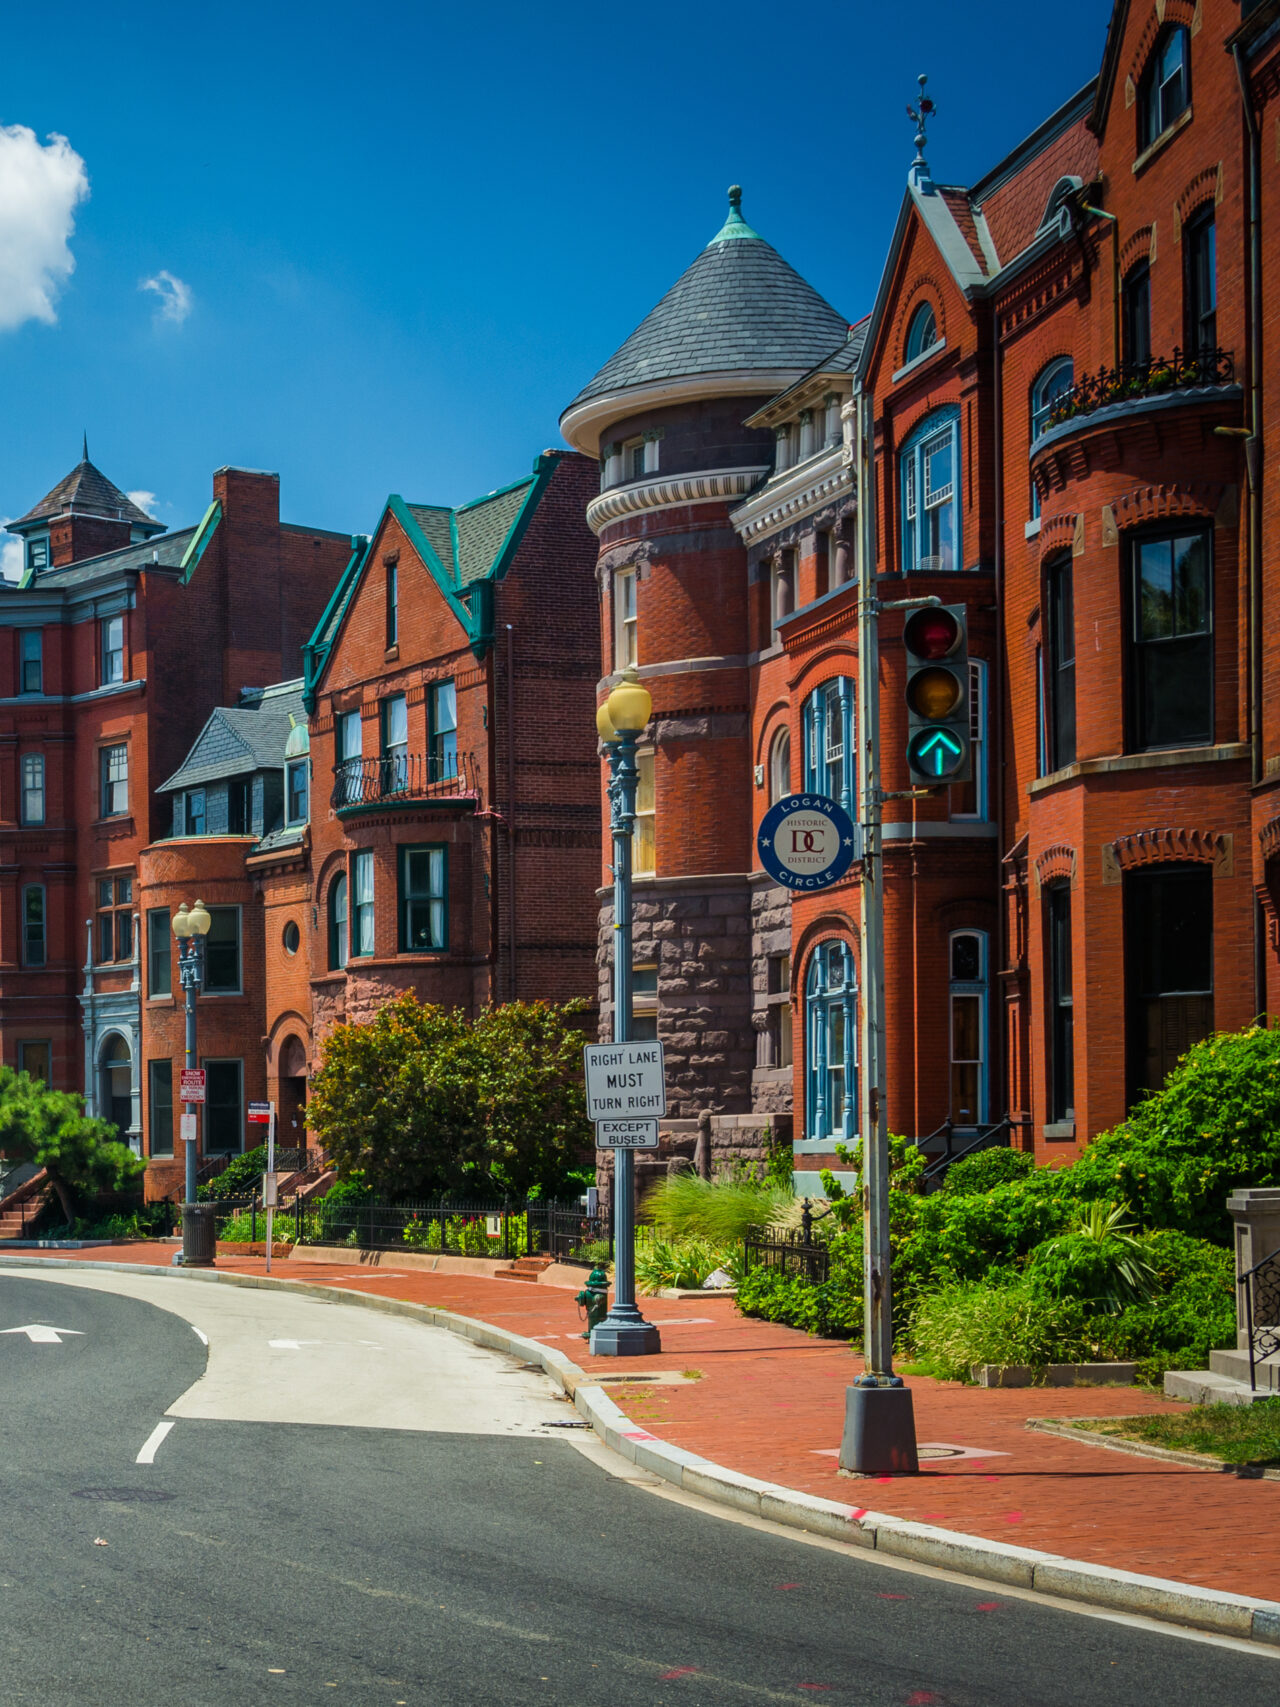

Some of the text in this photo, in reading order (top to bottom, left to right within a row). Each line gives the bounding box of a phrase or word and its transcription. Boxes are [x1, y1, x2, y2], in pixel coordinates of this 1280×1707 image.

[781, 798, 833, 812] LOGAN
[790, 830, 825, 853] DC
[779, 871, 834, 886] CIRCLE
[590, 1052, 658, 1066] RIGHT LANE
[607, 1073, 643, 1088] MUST
[593, 1095, 661, 1110] TURN RIGHT
[603, 1123, 651, 1132] EXCEPT
[609, 1135, 646, 1144] BUSES
